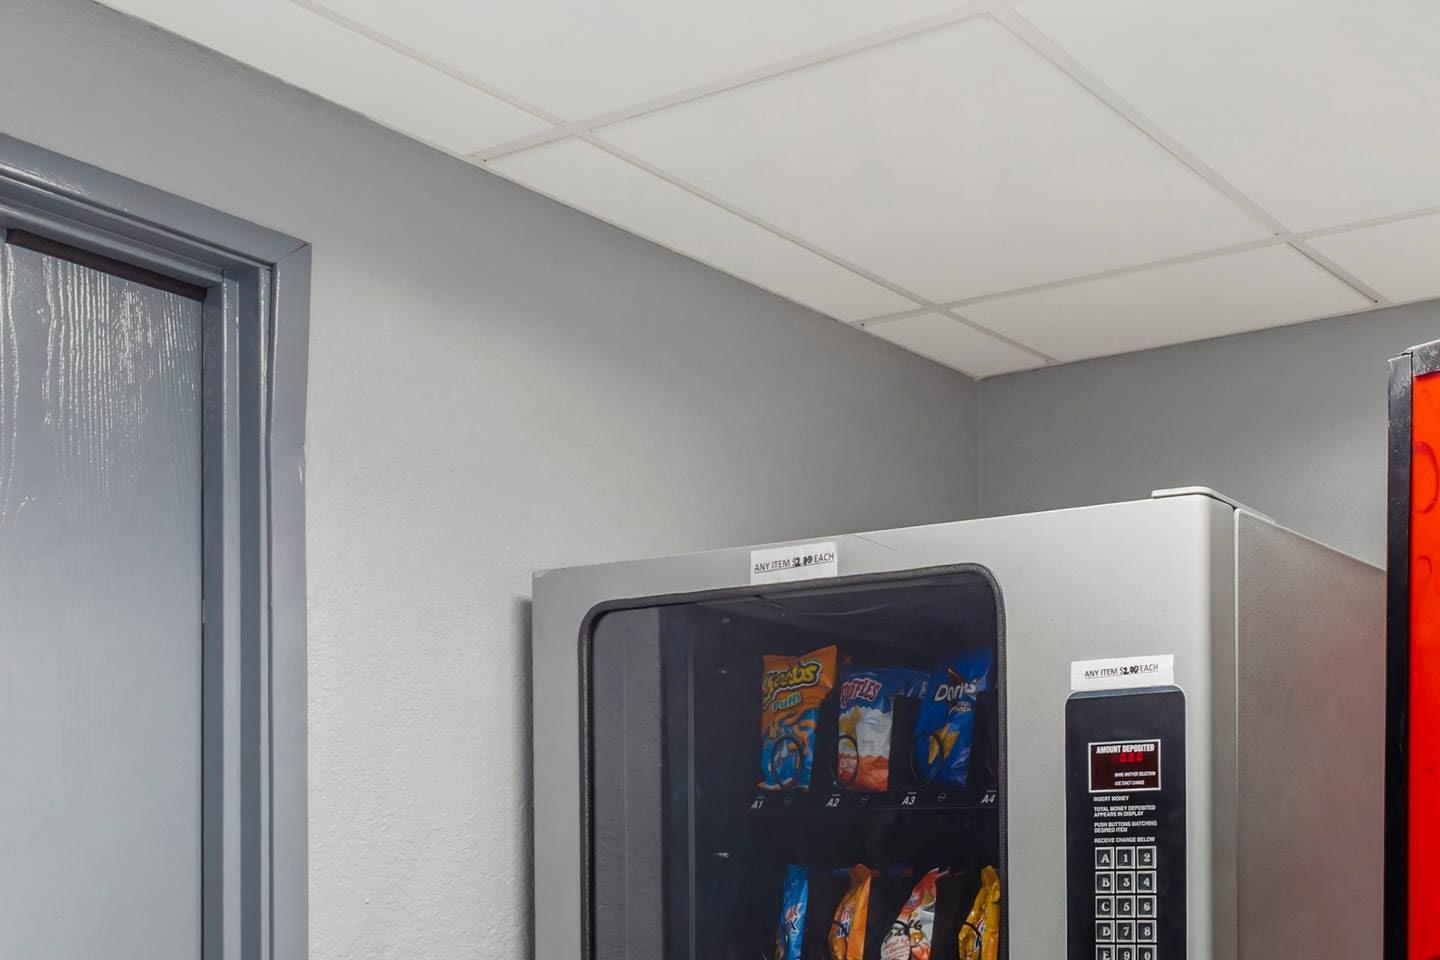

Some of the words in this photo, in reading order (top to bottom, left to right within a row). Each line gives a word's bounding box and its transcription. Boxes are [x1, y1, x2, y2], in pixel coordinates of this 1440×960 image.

[754, 563, 770, 572] ANY
[771, 559, 791, 569] ITEM
[814, 552, 835, 563] EACH
[1084, 670, 1099, 678] ANY
[1100, 668, 1118, 676] ITEM
[1140, 664, 1159, 672] EACH
[1096, 745, 1121, 754] AMOUNT
[1122, 744, 1155, 753] DEPOSITED
[826, 799, 840, 808] A2
[902, 797, 916, 806] A3
[981, 794, 996, 804] A4
[751, 800, 764, 809] A1
[1101, 854, 1110, 863] A
[1123, 854, 1129, 863] 1
[1143, 853, 1151, 862] 2
[1101, 878, 1110, 887] B
[1123, 878, 1130, 887] 3
[1143, 877, 1150, 886] 4
[1101, 902, 1110, 912] C
[1123, 902, 1130, 911] 5
[1143, 902, 1150, 911] 6
[1102, 927, 1111, 936] D
[1123, 927, 1130, 936] 7
[1144, 926, 1151, 935] 8
[1102, 951, 1110, 960] E
[1123, 951, 1130, 960] 9
[1144, 951, 1151, 960] 0
